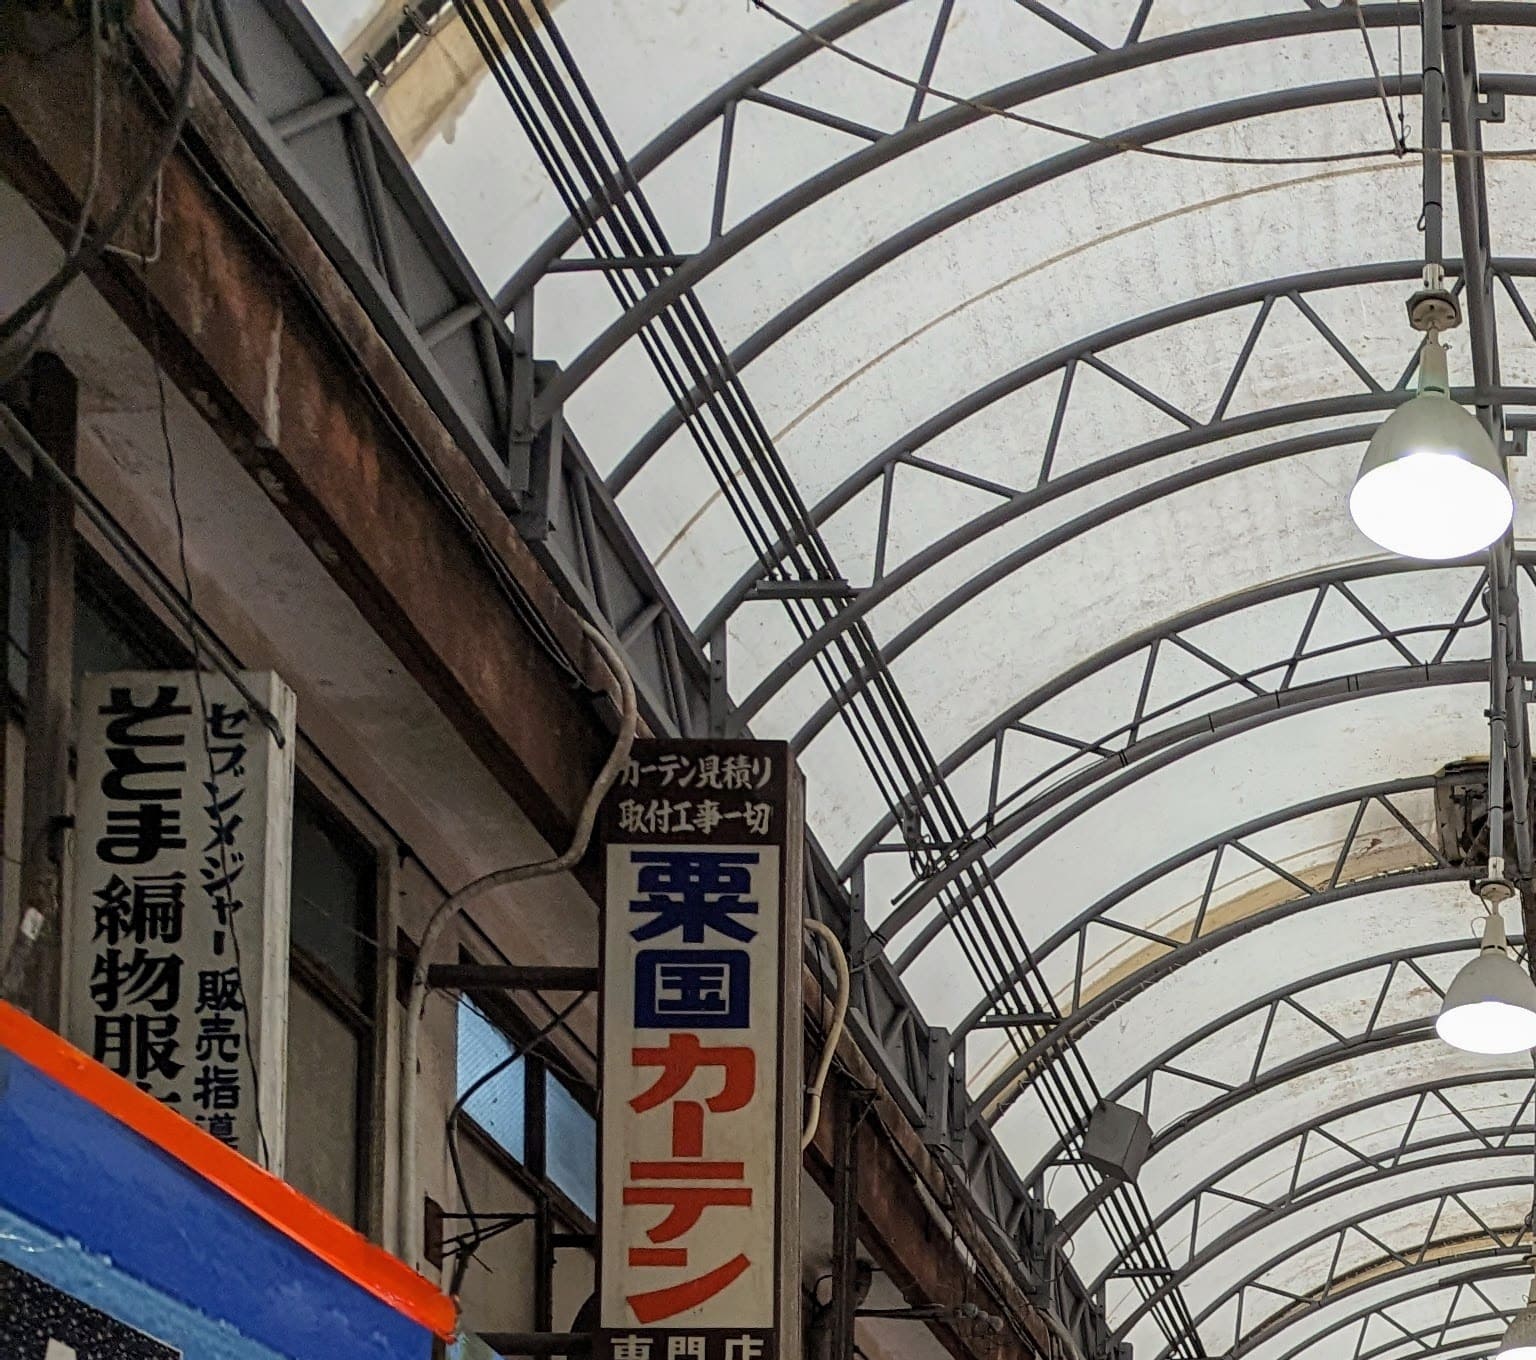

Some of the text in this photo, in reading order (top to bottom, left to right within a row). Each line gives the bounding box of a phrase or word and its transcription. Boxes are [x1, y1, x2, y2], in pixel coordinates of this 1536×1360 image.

[620, 755, 771, 789] カーテン見積り
[619, 799, 771, 834] 取付工事一切
[623, 851, 760, 1324] 粟国カーテン
